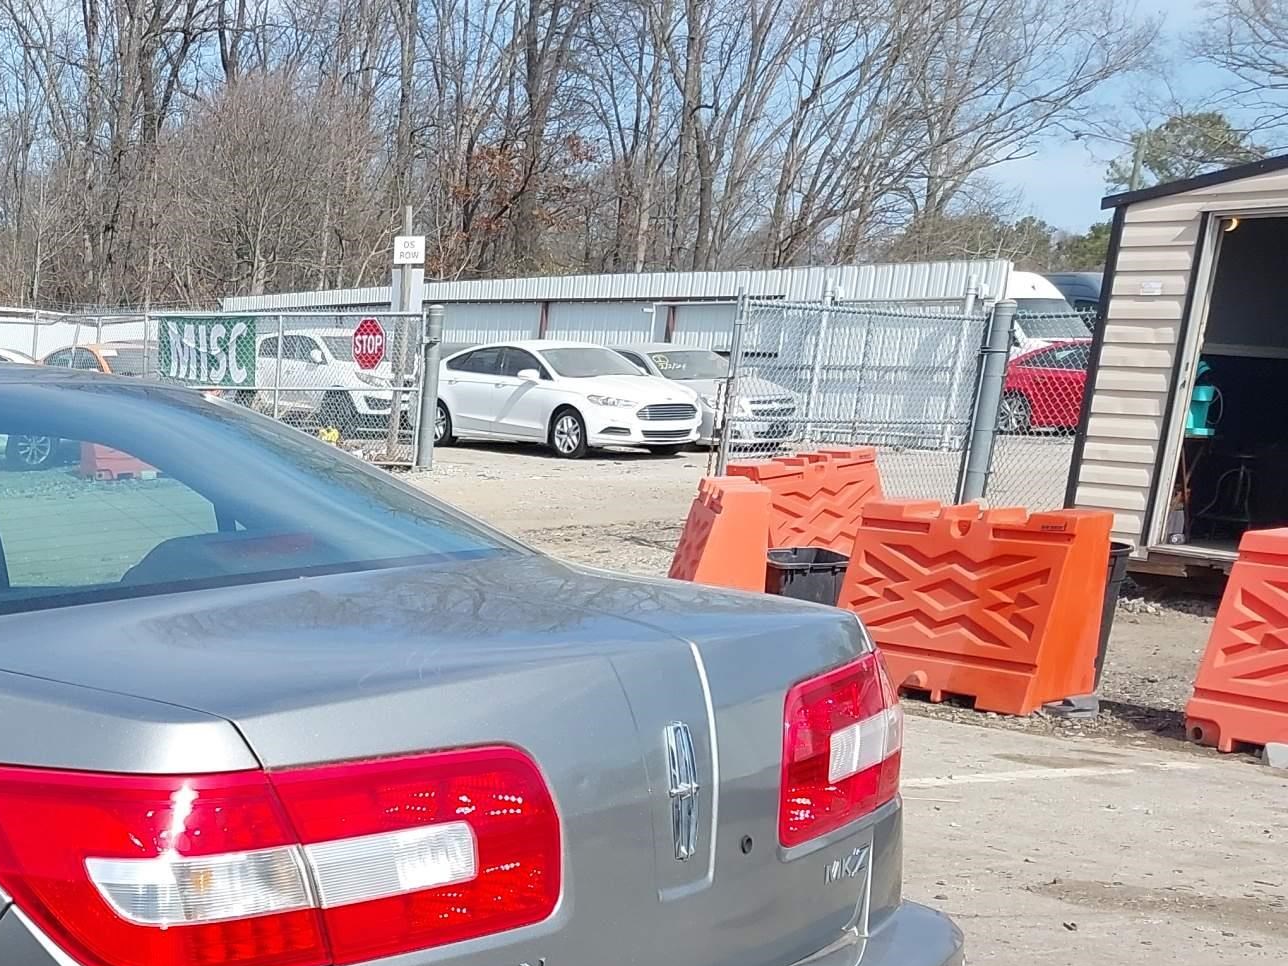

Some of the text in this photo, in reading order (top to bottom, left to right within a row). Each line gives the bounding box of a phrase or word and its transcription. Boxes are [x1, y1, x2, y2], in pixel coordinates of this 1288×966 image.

[399, 251, 419, 260] ROW
[167, 321, 248, 384] MISC
[354, 334, 382, 355] STOP
[823, 842, 870, 886] MKZ
